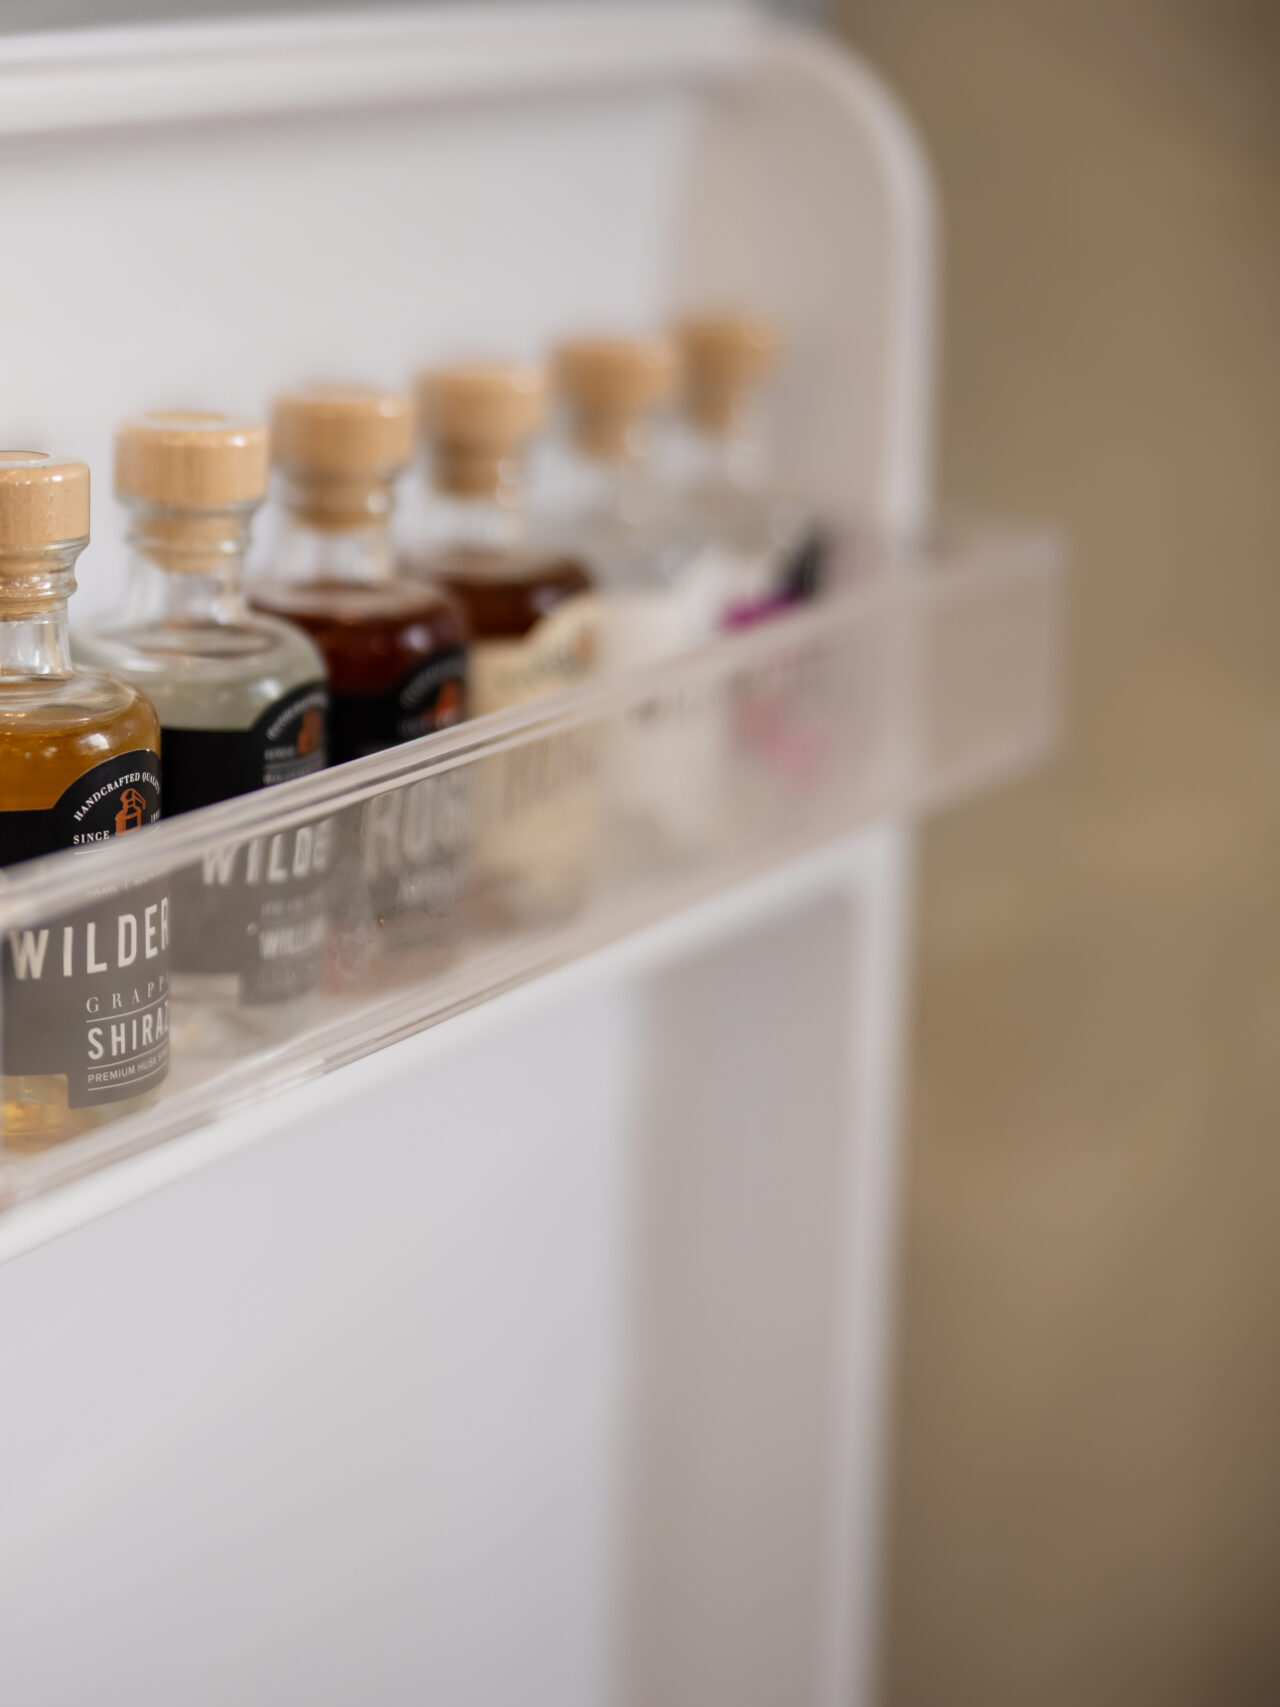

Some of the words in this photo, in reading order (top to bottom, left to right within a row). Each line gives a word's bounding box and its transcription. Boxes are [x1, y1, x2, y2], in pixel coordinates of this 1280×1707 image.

[73, 772, 140, 821] HANDCRAFTED
[73, 830, 111, 845] SINCE
[8, 896, 169, 979] WILDER
[86, 975, 169, 1013] GRAPP
[87, 1065, 136, 1083] PREMIUM
